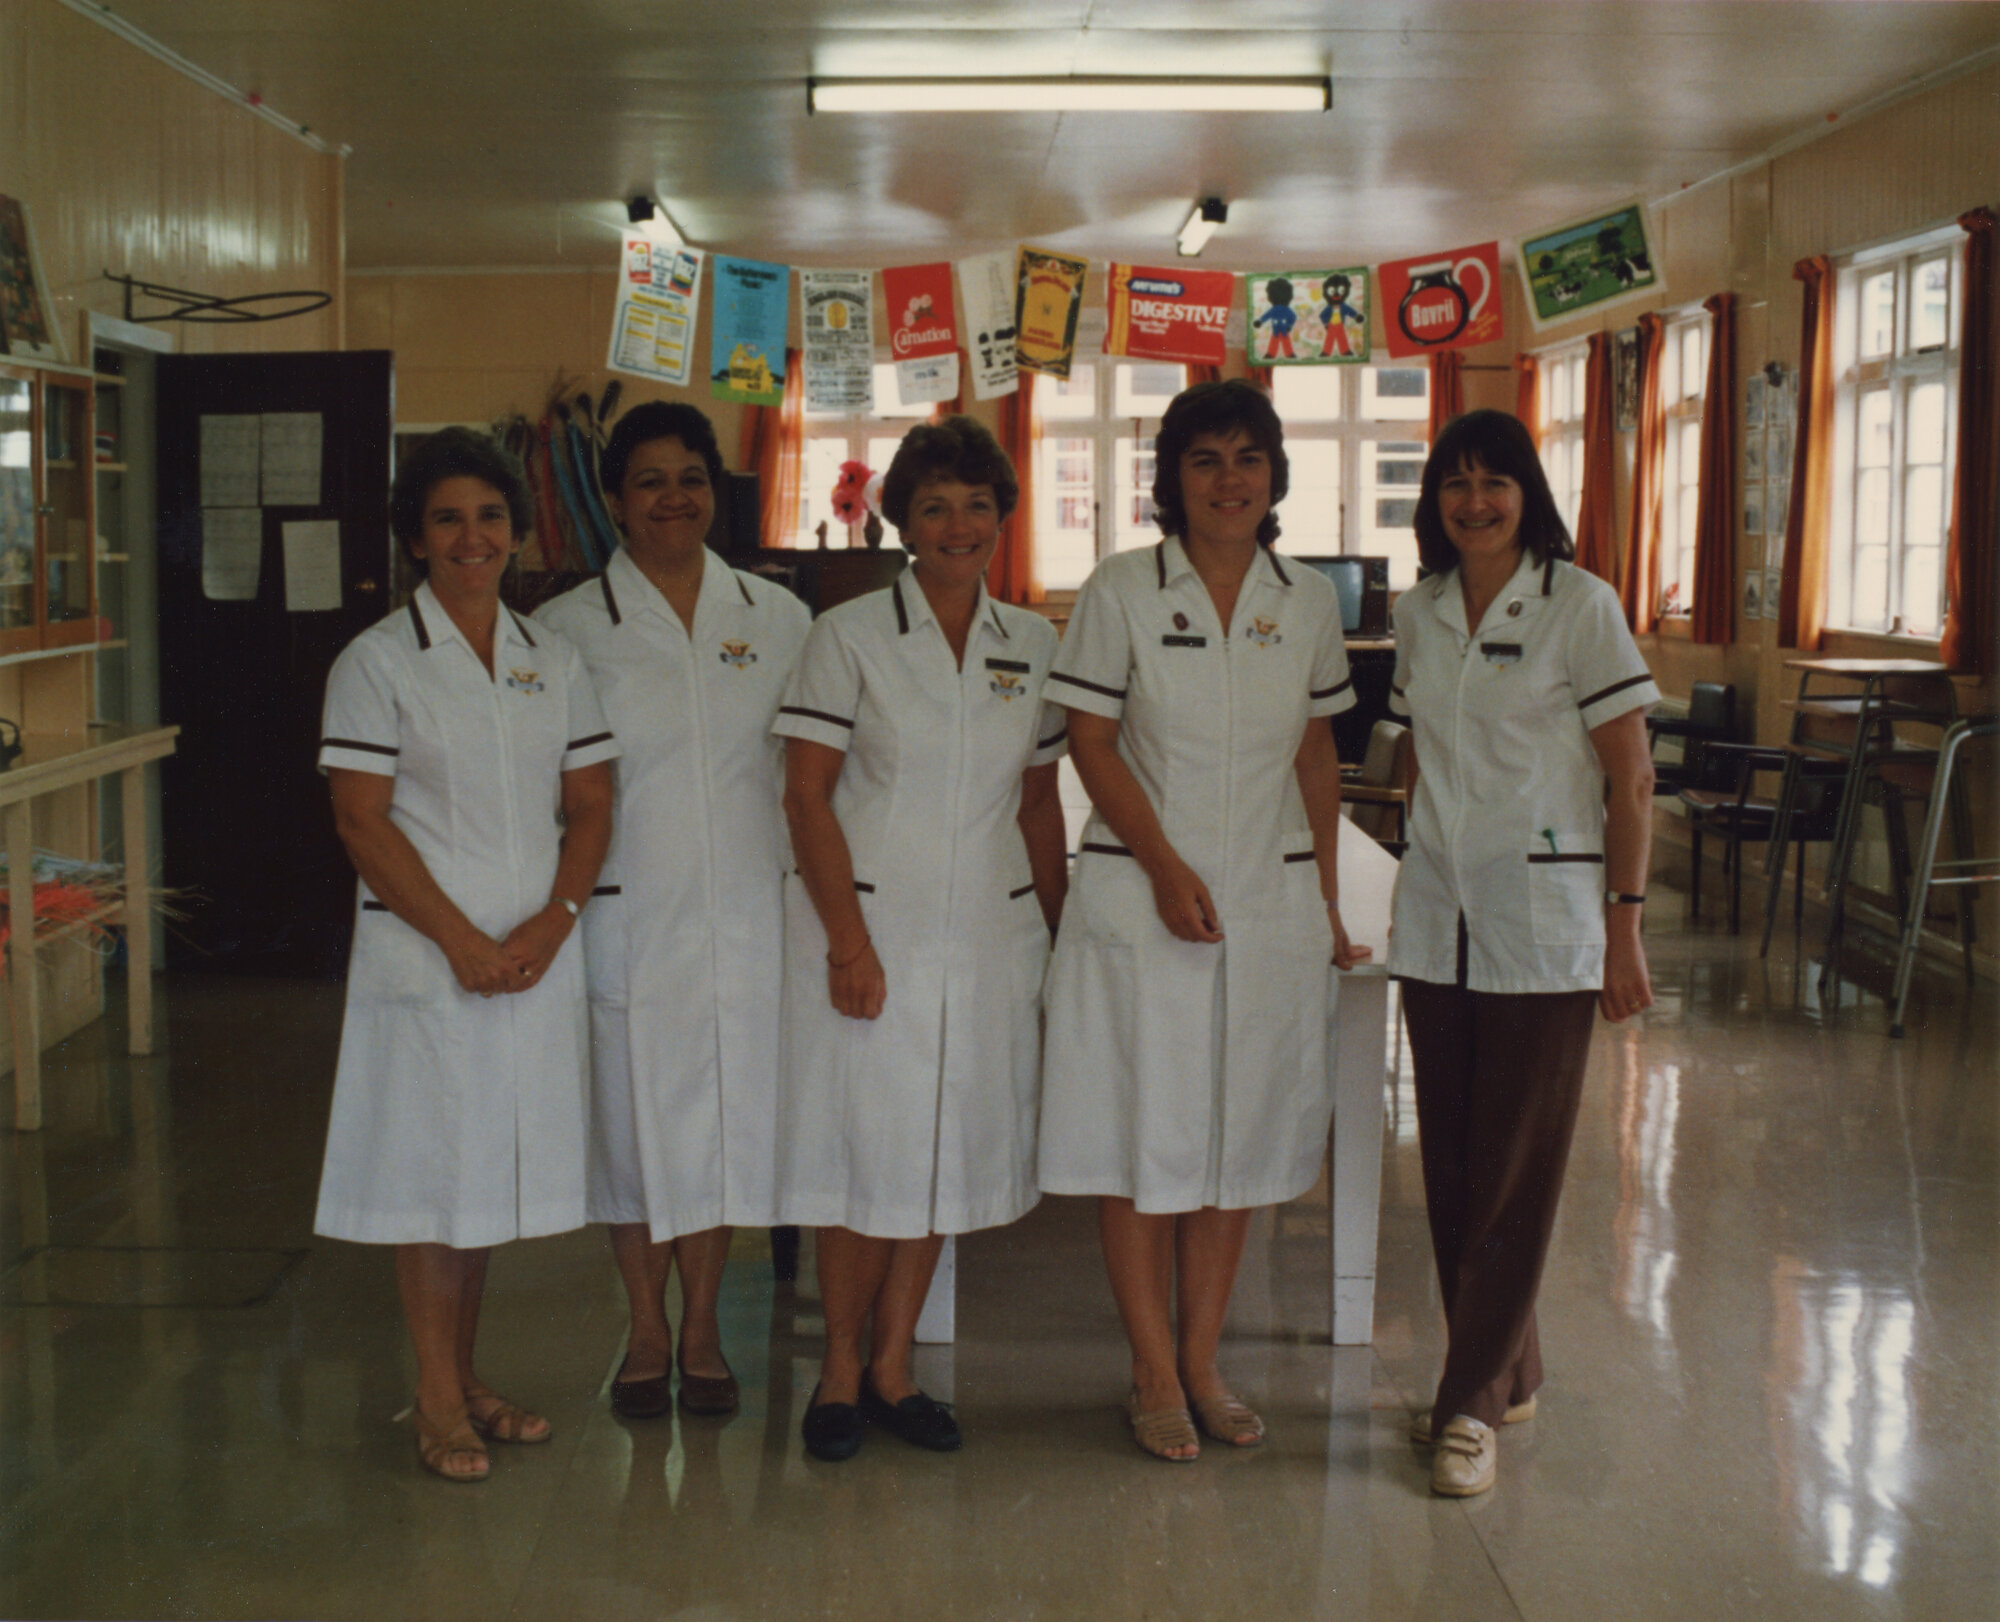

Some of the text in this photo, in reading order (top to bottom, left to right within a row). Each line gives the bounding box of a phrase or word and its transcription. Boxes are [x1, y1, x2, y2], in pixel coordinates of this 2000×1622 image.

[1130, 299, 1227, 324] DIGESTIVE
[1411, 298, 1455, 329] Bovril
[893, 327, 952, 354] Carnation
